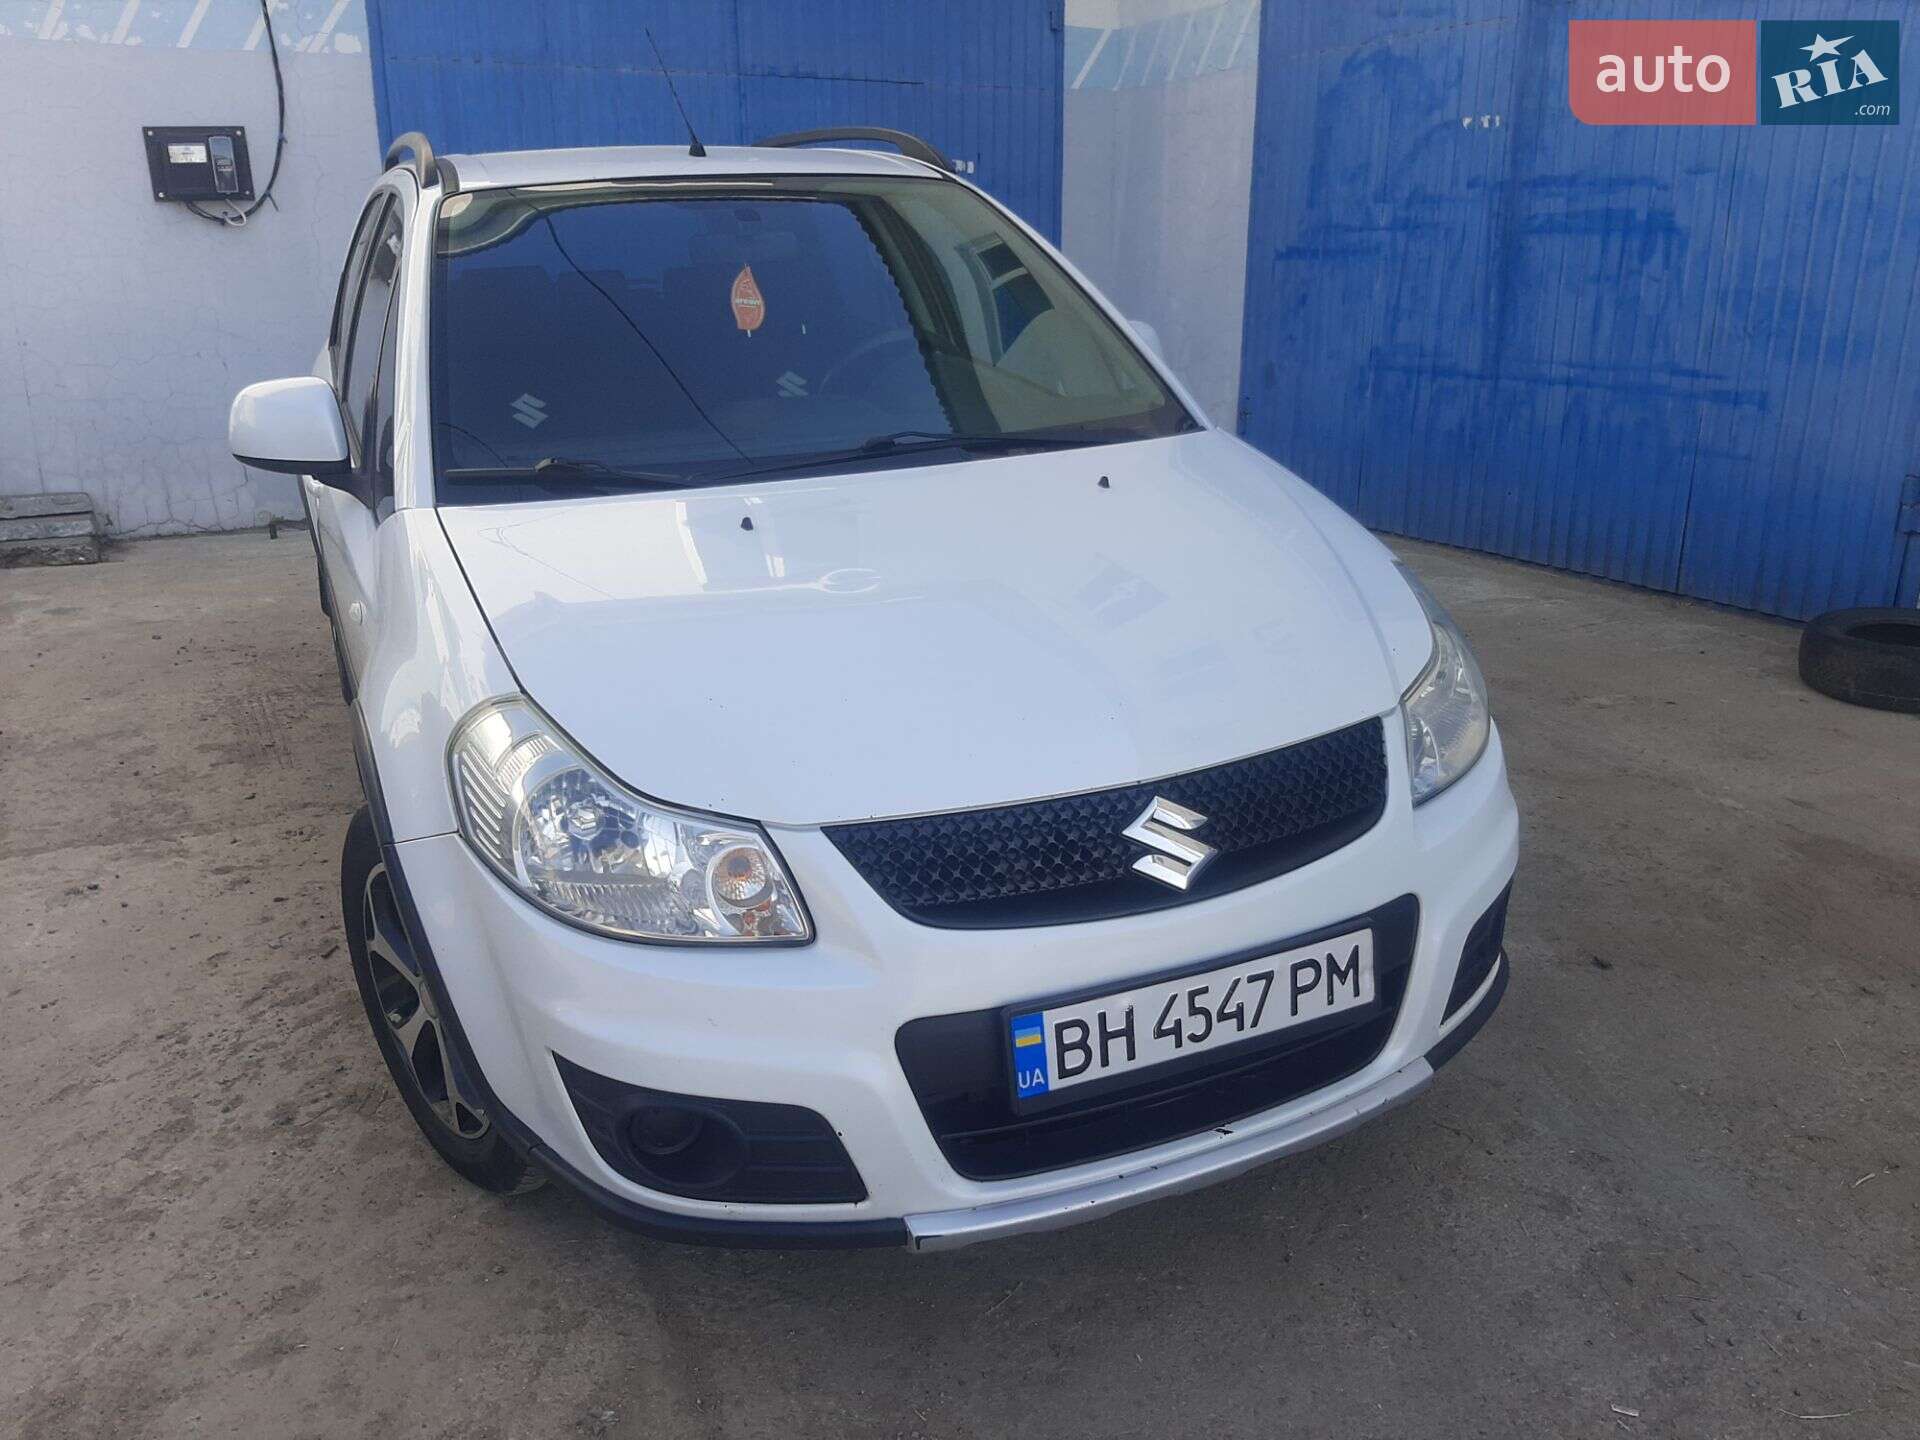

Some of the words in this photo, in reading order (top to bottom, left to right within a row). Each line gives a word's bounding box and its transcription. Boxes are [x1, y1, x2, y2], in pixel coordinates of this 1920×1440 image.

[1054, 1005, 1136, 1080] BH
[1152, 970, 1275, 1049] 4547
[1290, 944, 1360, 1017] PM
[1018, 1068, 1045, 1089] UA
